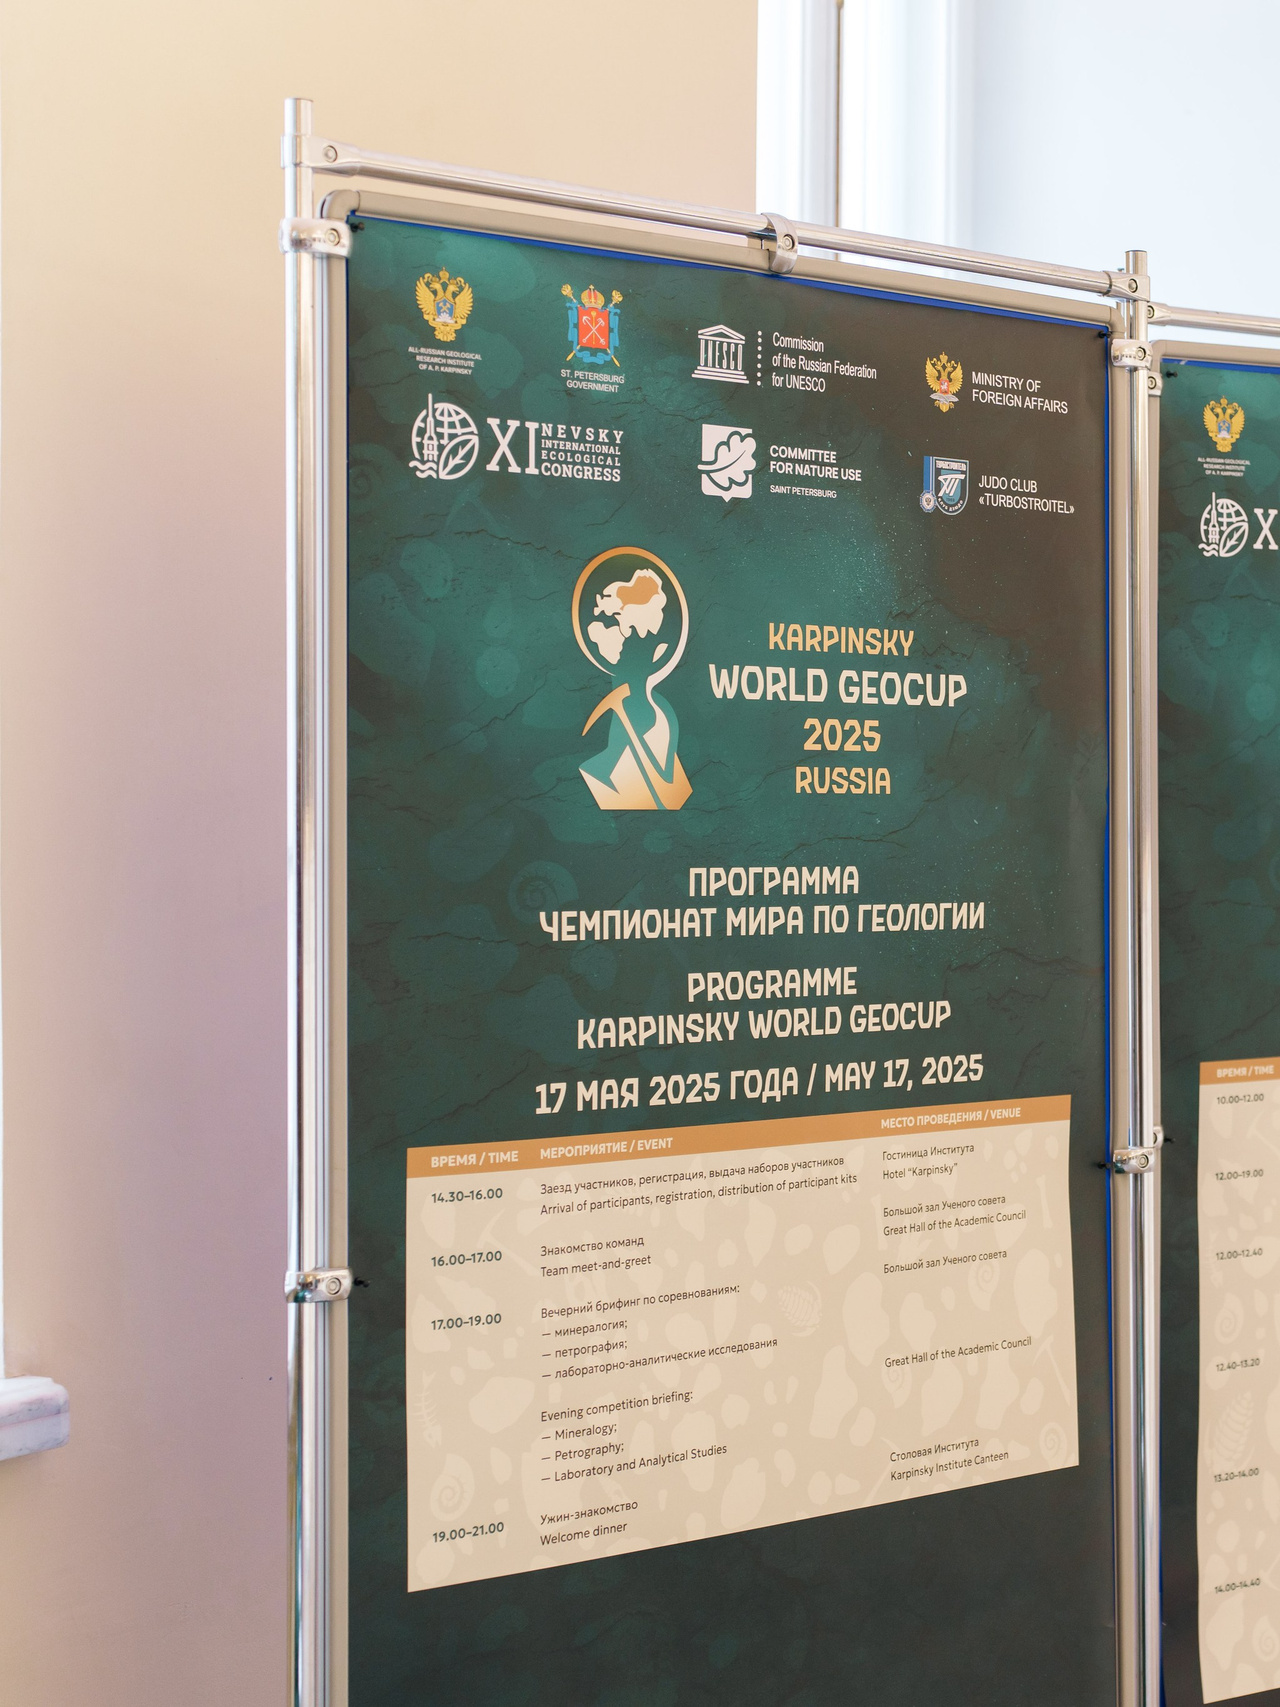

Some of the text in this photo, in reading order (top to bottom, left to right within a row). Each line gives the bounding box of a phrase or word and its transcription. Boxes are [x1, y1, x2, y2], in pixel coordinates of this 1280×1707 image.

[772, 331, 824, 352] Commission
[408, 346, 482, 360] ALL-RUSSIAN GEOLOGICAL
[416, 354, 474, 367] RESEARCH INSTITUTE
[698, 339, 743, 371] UNESCO
[440, 366, 472, 375] KARPINSKY
[560, 369, 625, 384] ST. PETERSBURG
[772, 353, 877, 379] of the Russian Federation
[566, 379, 619, 393] GOVERNMENT
[771, 372, 826, 392] for UNESCO
[971, 371, 1041, 392] MINISTRY OF
[972, 388, 1068, 414] FOREIGN AFFAIRS
[541, 422, 624, 444] NEVSKY
[485, 417, 539, 475] XI
[541, 439, 621, 455] INTERNATIONAL
[769, 445, 837, 463] COMMITTEE
[541, 450, 621, 466] ECOLOGICAL
[541, 462, 620, 482] CONGRESS
[770, 460, 862, 481] FOR NATURE USE
[769, 484, 837, 498] SAINT PETERSBURG
[978, 475, 1037, 493] JUDO CLUB
[978, 493, 1074, 514] «TURBOSTROITEL»
[769, 622, 914, 656] KARPINSKY
[708, 663, 967, 707] WORLD GEOCUP
[803, 717, 881, 752] 2025
[795, 766, 890, 794] RUSSIA
[689, 865, 859, 897] ПРОГРАММА
[539, 901, 984, 941] ЧЕМПИОНАТ МИРА ПО ГЕОЛОГИИ
[687, 966, 857, 1002] PROGRAMME
[577, 1000, 951, 1049] KARPINSKY WORLD GEOCUP
[1216, 1064, 1274, 1078] ВРЕМЯ / TIME
[535, 1053, 983, 1114] 17 МАЯ 2025 ГОДА / MAY 17, 2025
[881, 1107, 1021, 1129] МЕСТО ПРОВЕДЕНИЯ / VENUE
[540, 1137, 673, 1159] МЕРОПРИЯТИЕ / EVENT
[882, 1144, 974, 1161] Гостиница Института
[431, 1150, 518, 1168] ВРЕМЯ / TIME
[540, 1157, 844, 1195] Заезд участников, регистрация, выдача наборов участников
[882, 1163, 958, 1179] Hotel “Karpinsky”
[540, 1175, 857, 1215] Arrival of participants, registration, distribution of participant kits
[540, 1501, 638, 1525] Ужин-знакомство
[539, 1523, 627, 1546] Welcome dinner
